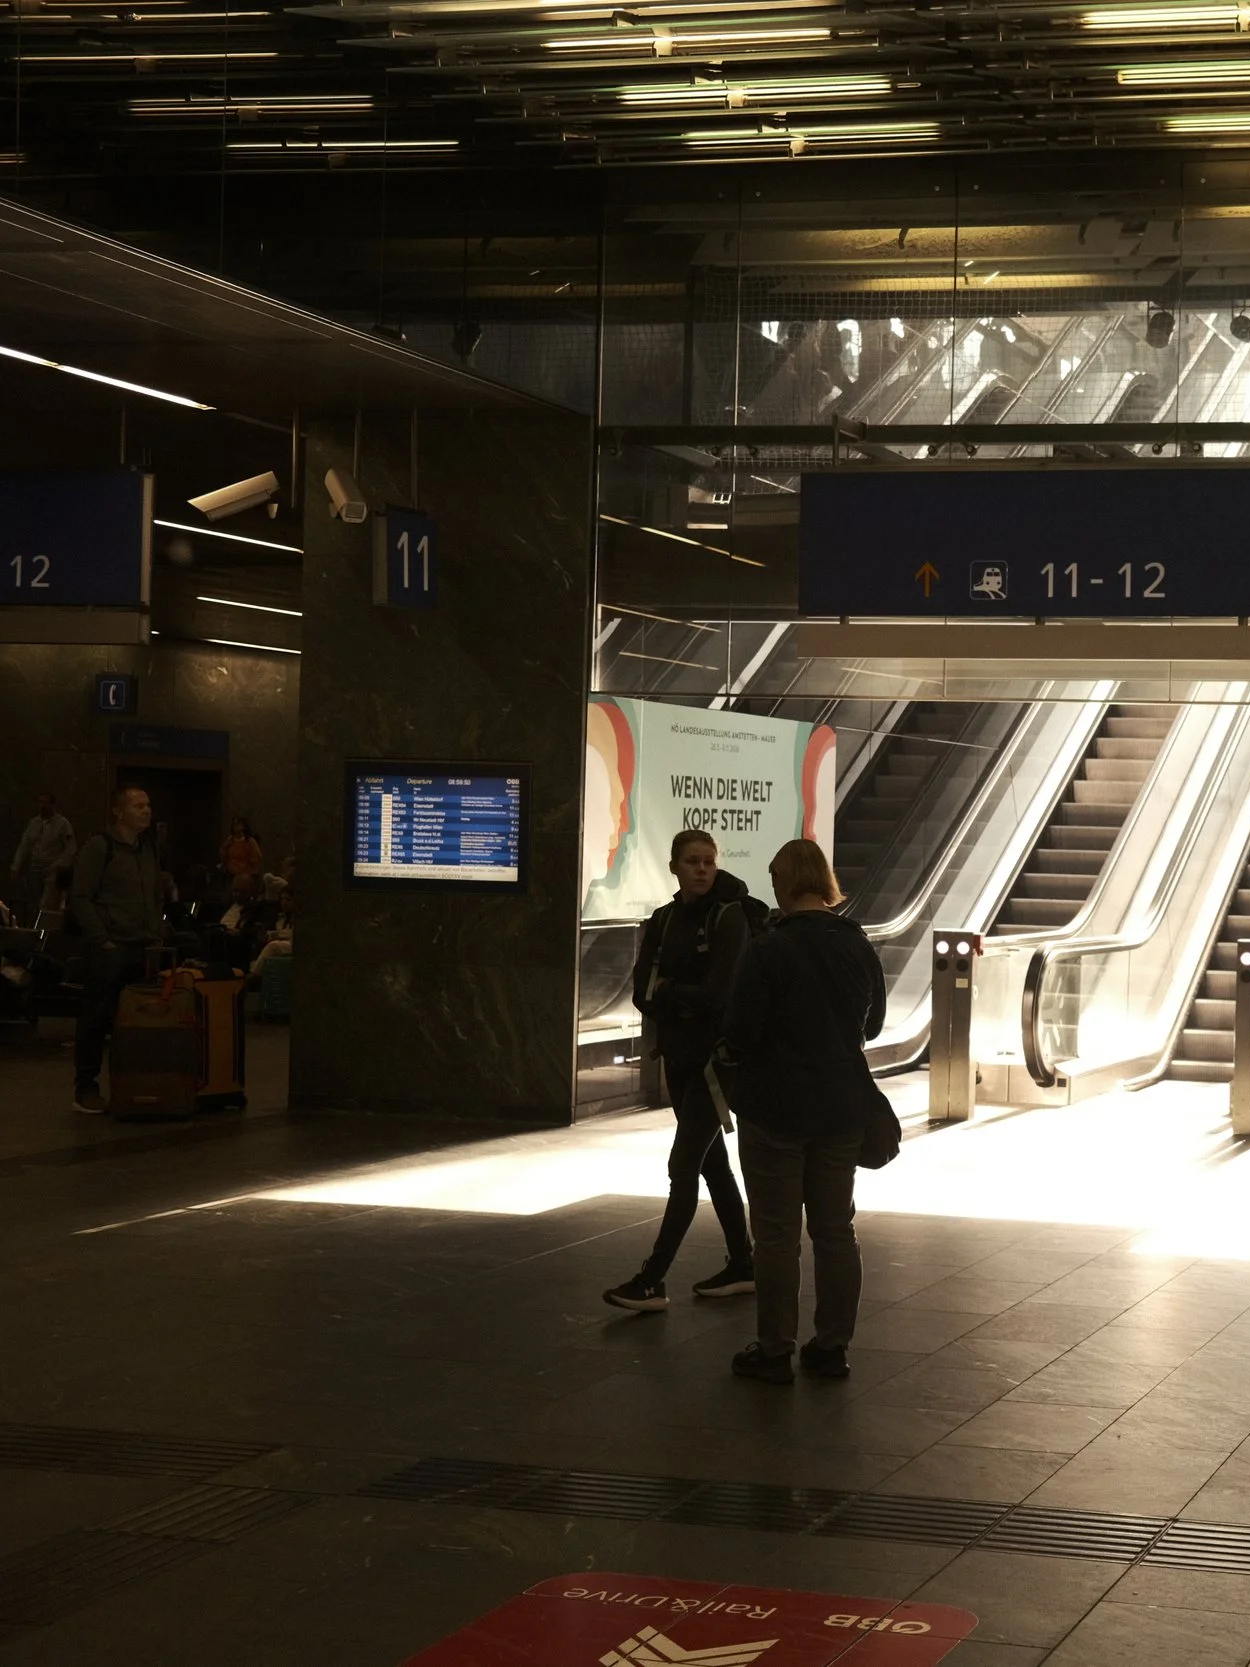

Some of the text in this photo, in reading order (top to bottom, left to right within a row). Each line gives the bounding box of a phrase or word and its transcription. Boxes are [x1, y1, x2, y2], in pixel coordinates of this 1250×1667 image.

[9, 554, 52, 588] 12
[397, 530, 430, 592] 11
[680, 725, 731, 739] LANDESAUSSTELLUNG
[732, 731, 758, 742] AMSTETTEN
[670, 774, 773, 803] WENN DIE WELT
[683, 807, 761, 832] KOPF STEHT
[563, 1586, 778, 1620] Rail&Drive
[822, 1612, 933, 1636] ÖBB
